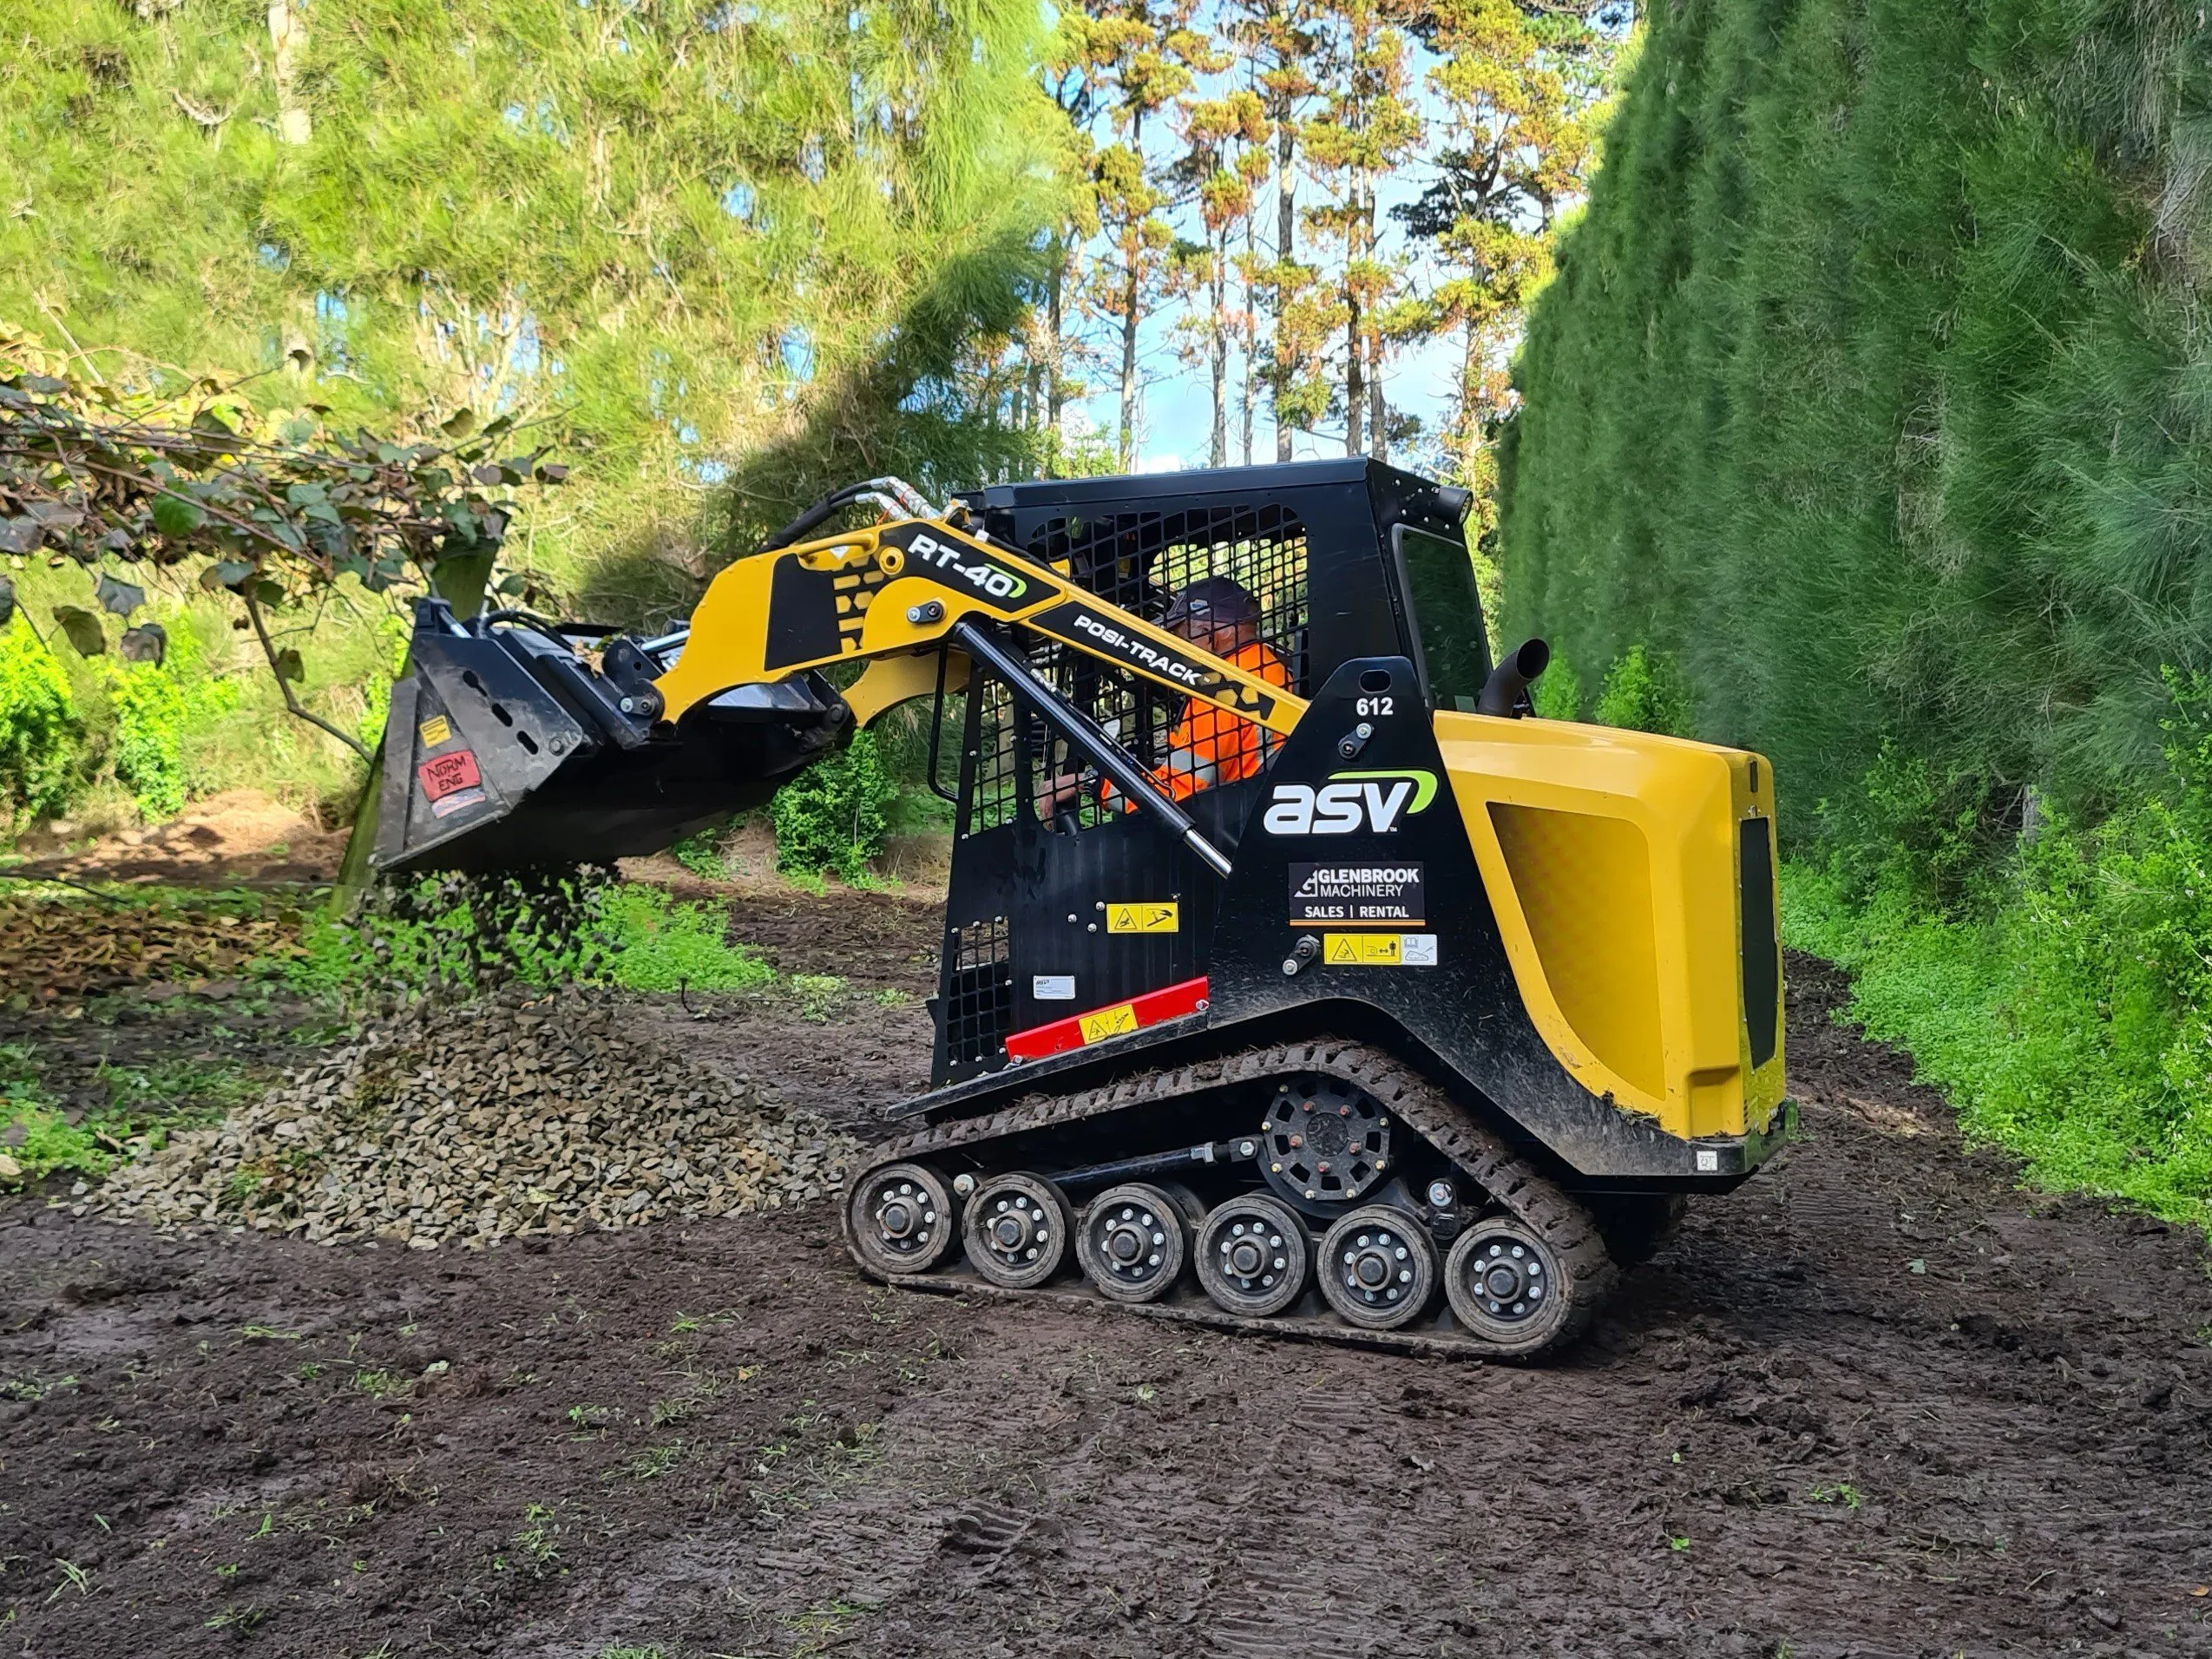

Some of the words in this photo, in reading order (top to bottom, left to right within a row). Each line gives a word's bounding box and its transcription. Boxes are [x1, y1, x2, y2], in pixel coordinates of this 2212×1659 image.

[907, 533, 1013, 597] RT-40
[1073, 614, 1203, 686] POSI-TRACK
[1355, 697, 1394, 717] 612
[425, 755, 467, 782] NORM
[438, 772, 463, 791] ENG
[1317, 868, 1420, 884] GLENBROOK
[1320, 883, 1404, 898] MACHINERY
[1304, 905, 1344, 918] SALES
[1359, 905, 1410, 918] RENTAL
